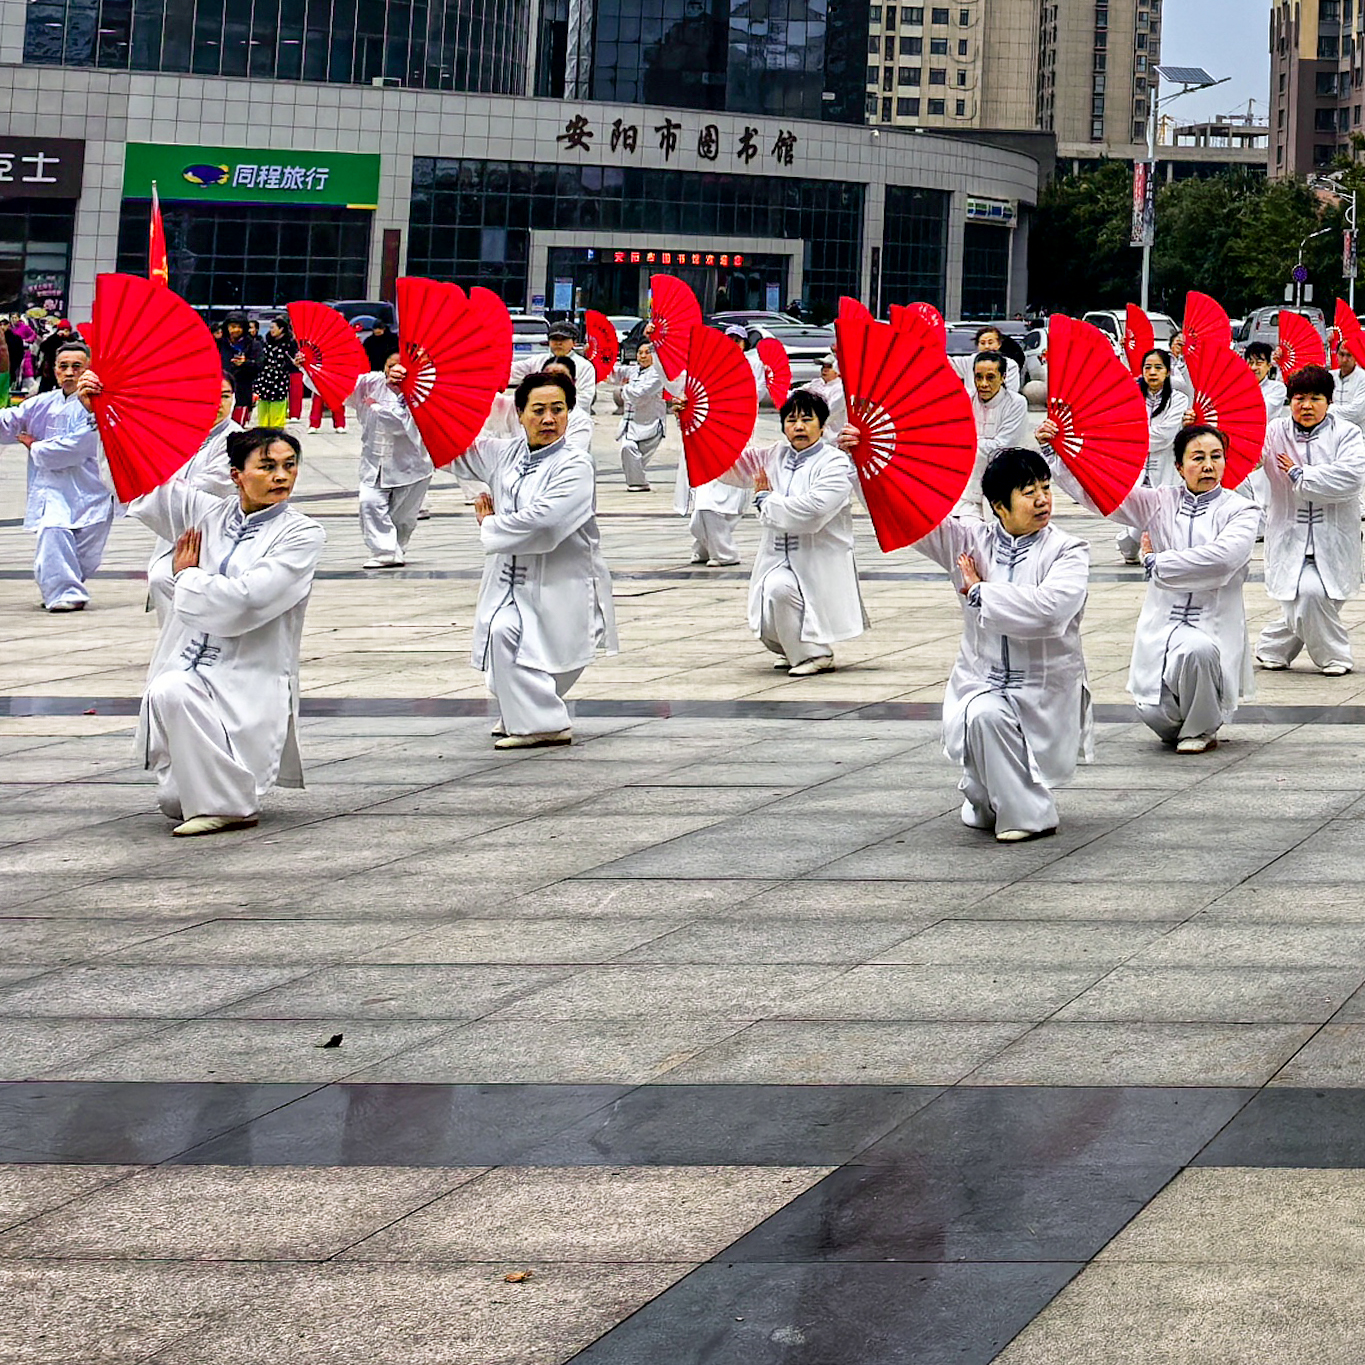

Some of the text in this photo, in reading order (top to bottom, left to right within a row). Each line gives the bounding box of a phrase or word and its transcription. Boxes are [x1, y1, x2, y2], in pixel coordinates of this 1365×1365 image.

[556, 114, 797, 167] 安阳市图书馆
[232, 164, 330, 190] 同程旅行
